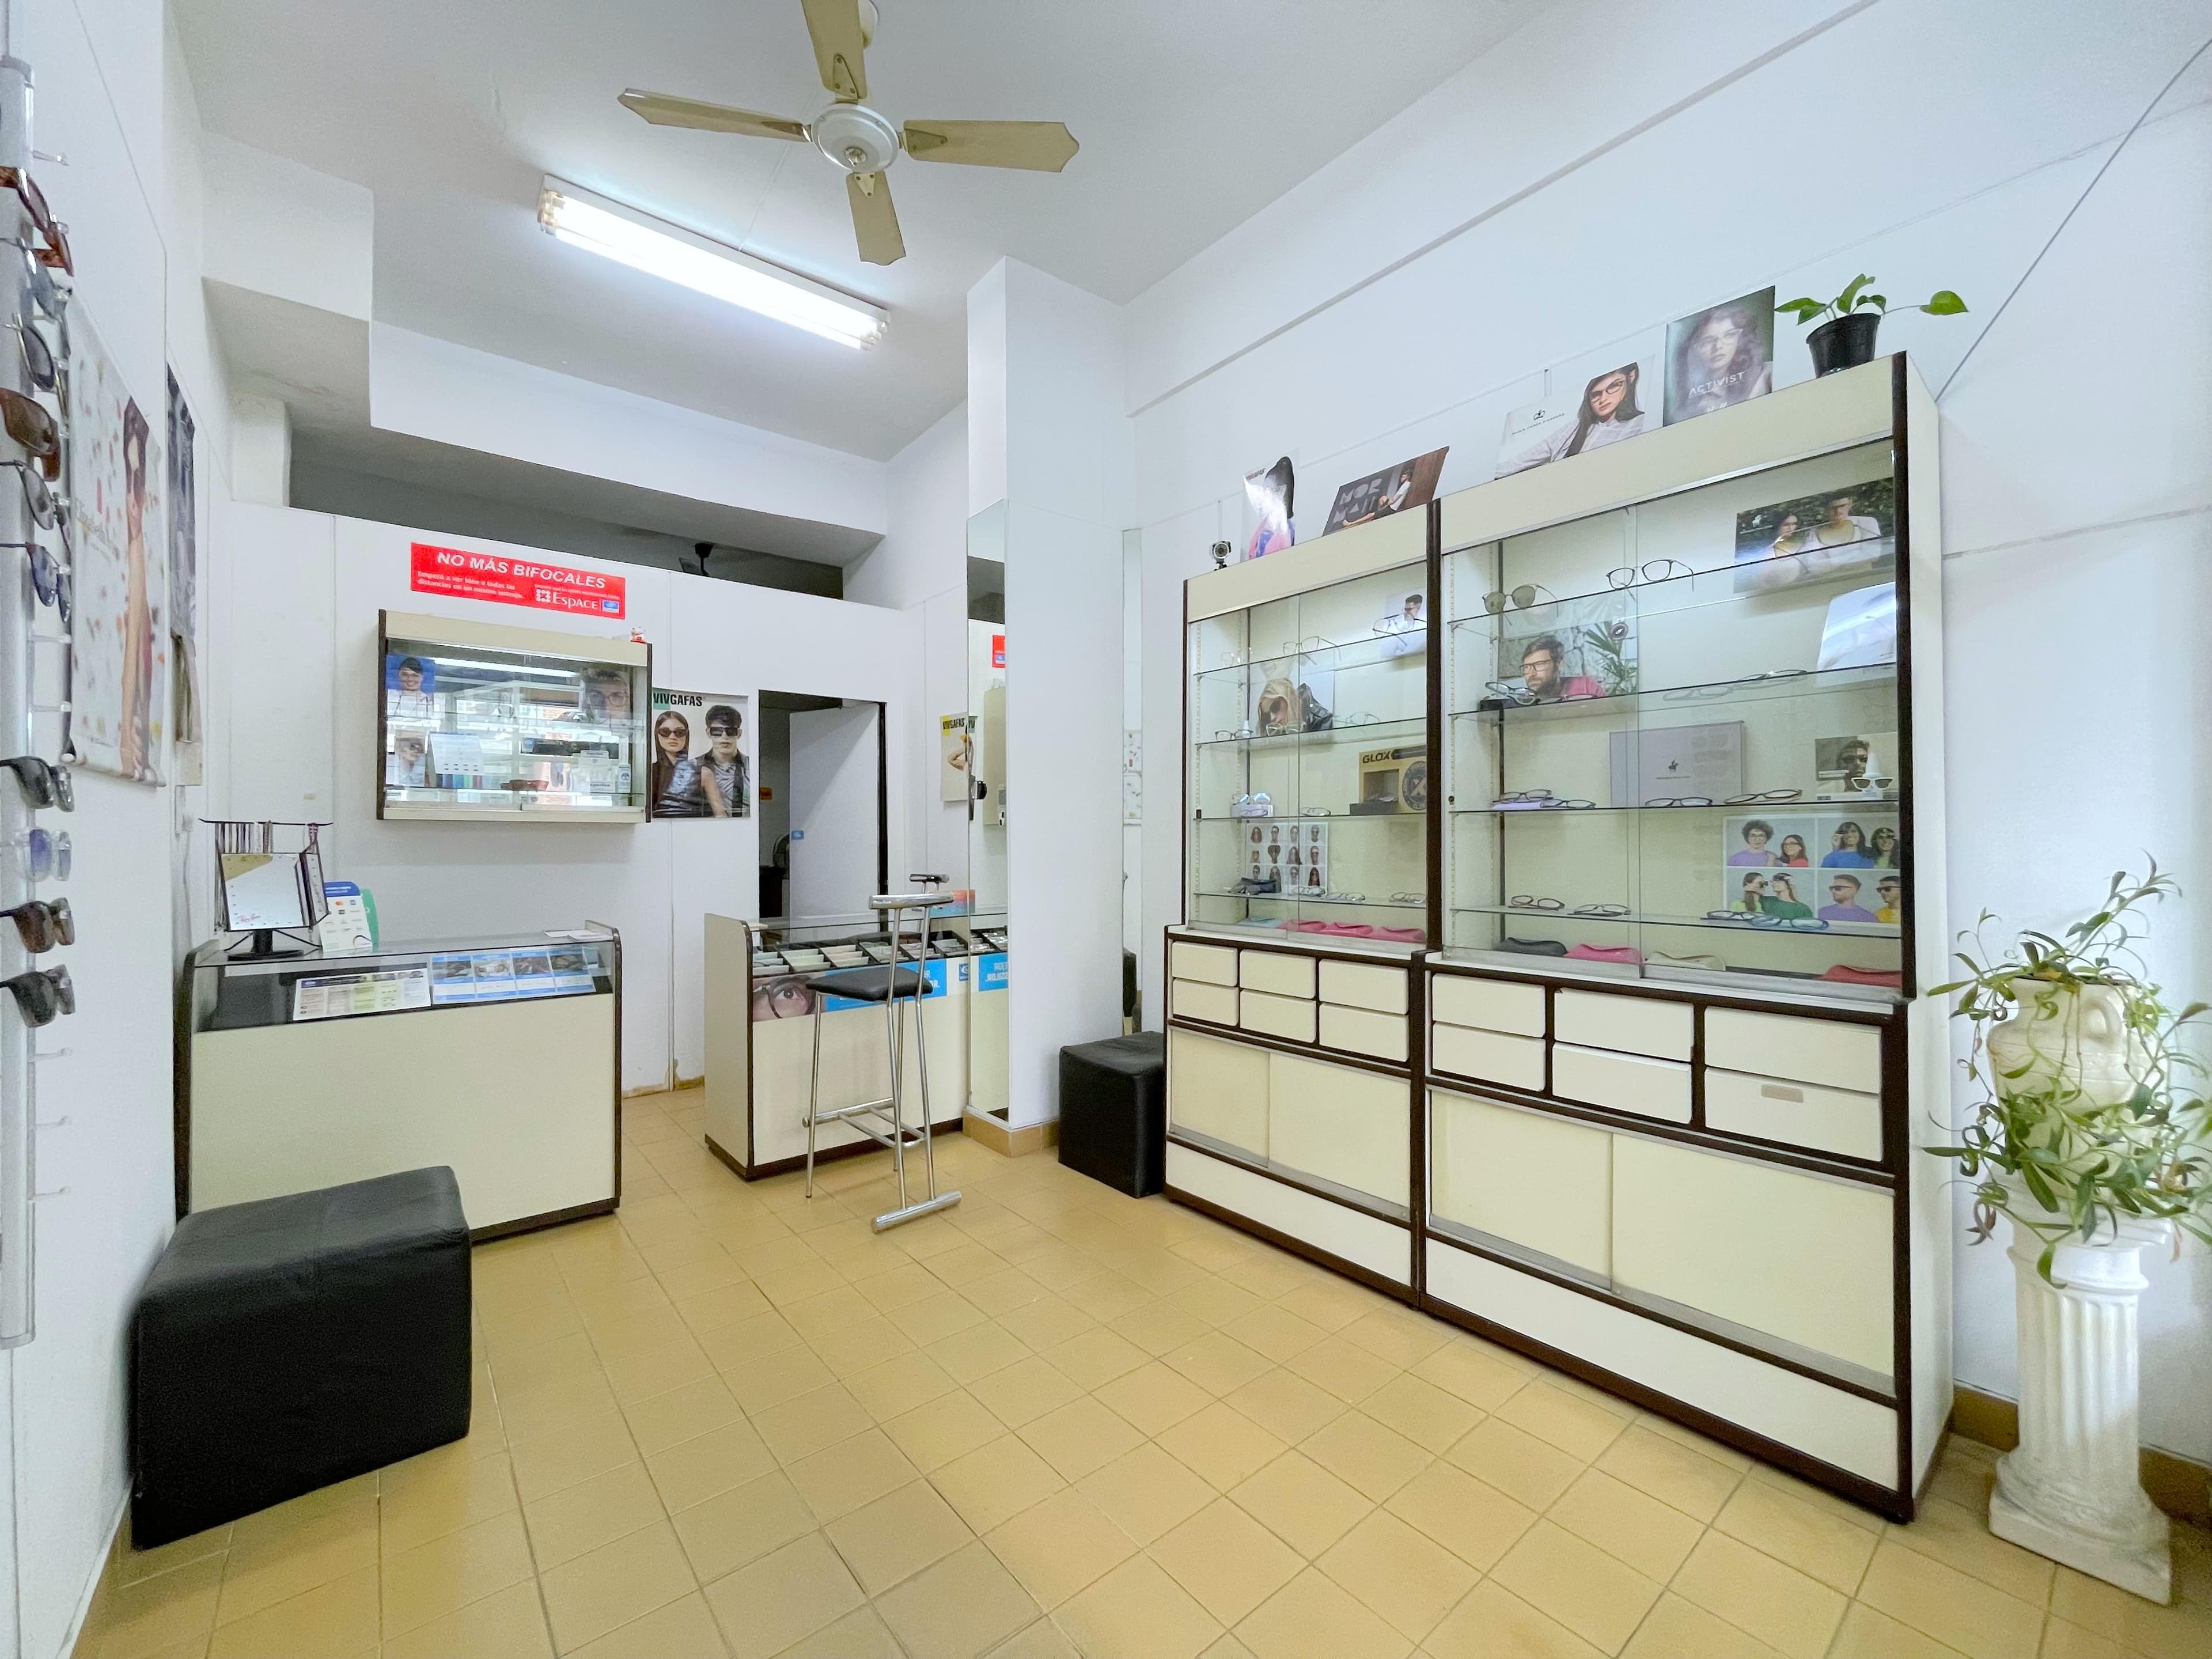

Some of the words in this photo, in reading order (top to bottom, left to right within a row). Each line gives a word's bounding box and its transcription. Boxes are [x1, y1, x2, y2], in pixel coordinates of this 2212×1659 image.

[1688, 372, 1745, 396] ACTIVIST
[1338, 478, 1382, 505] MOR
[437, 552, 465, 567] NO
[469, 556, 509, 574] MÁS
[513, 564, 606, 589] BIFOCALES
[653, 693, 703, 707] VIVGAFAS
[1362, 751, 1391, 764] GLOX
